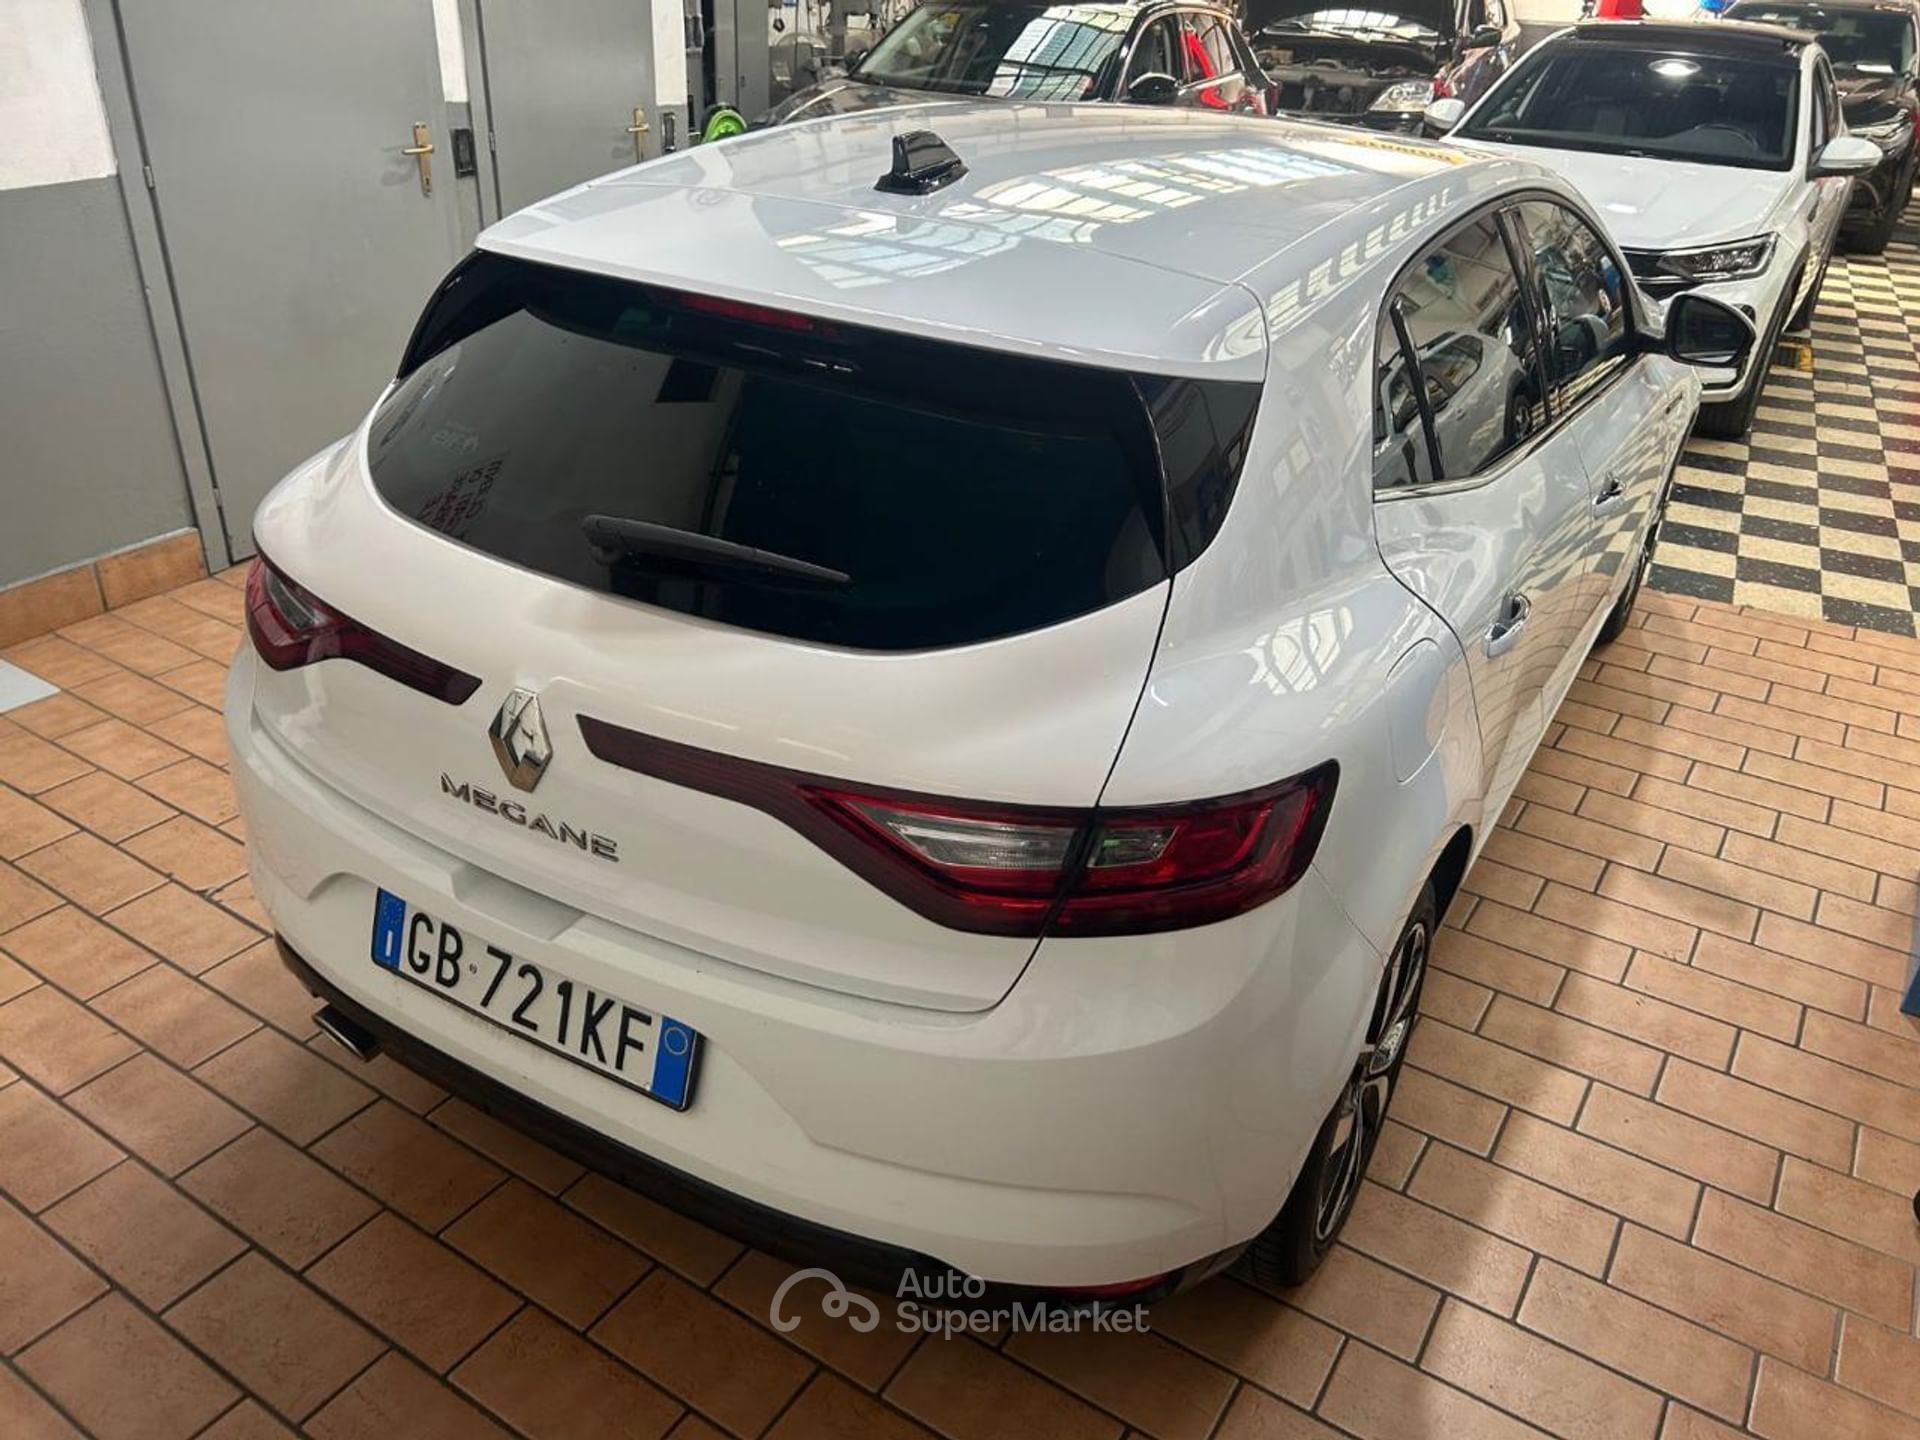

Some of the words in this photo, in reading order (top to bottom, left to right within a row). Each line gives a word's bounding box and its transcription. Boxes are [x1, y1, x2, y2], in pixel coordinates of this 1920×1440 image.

[440, 773, 619, 862] MEGANE
[385, 930, 393, 956] I
[407, 912, 463, 988] GB
[481, 946, 651, 1070] 721KF
